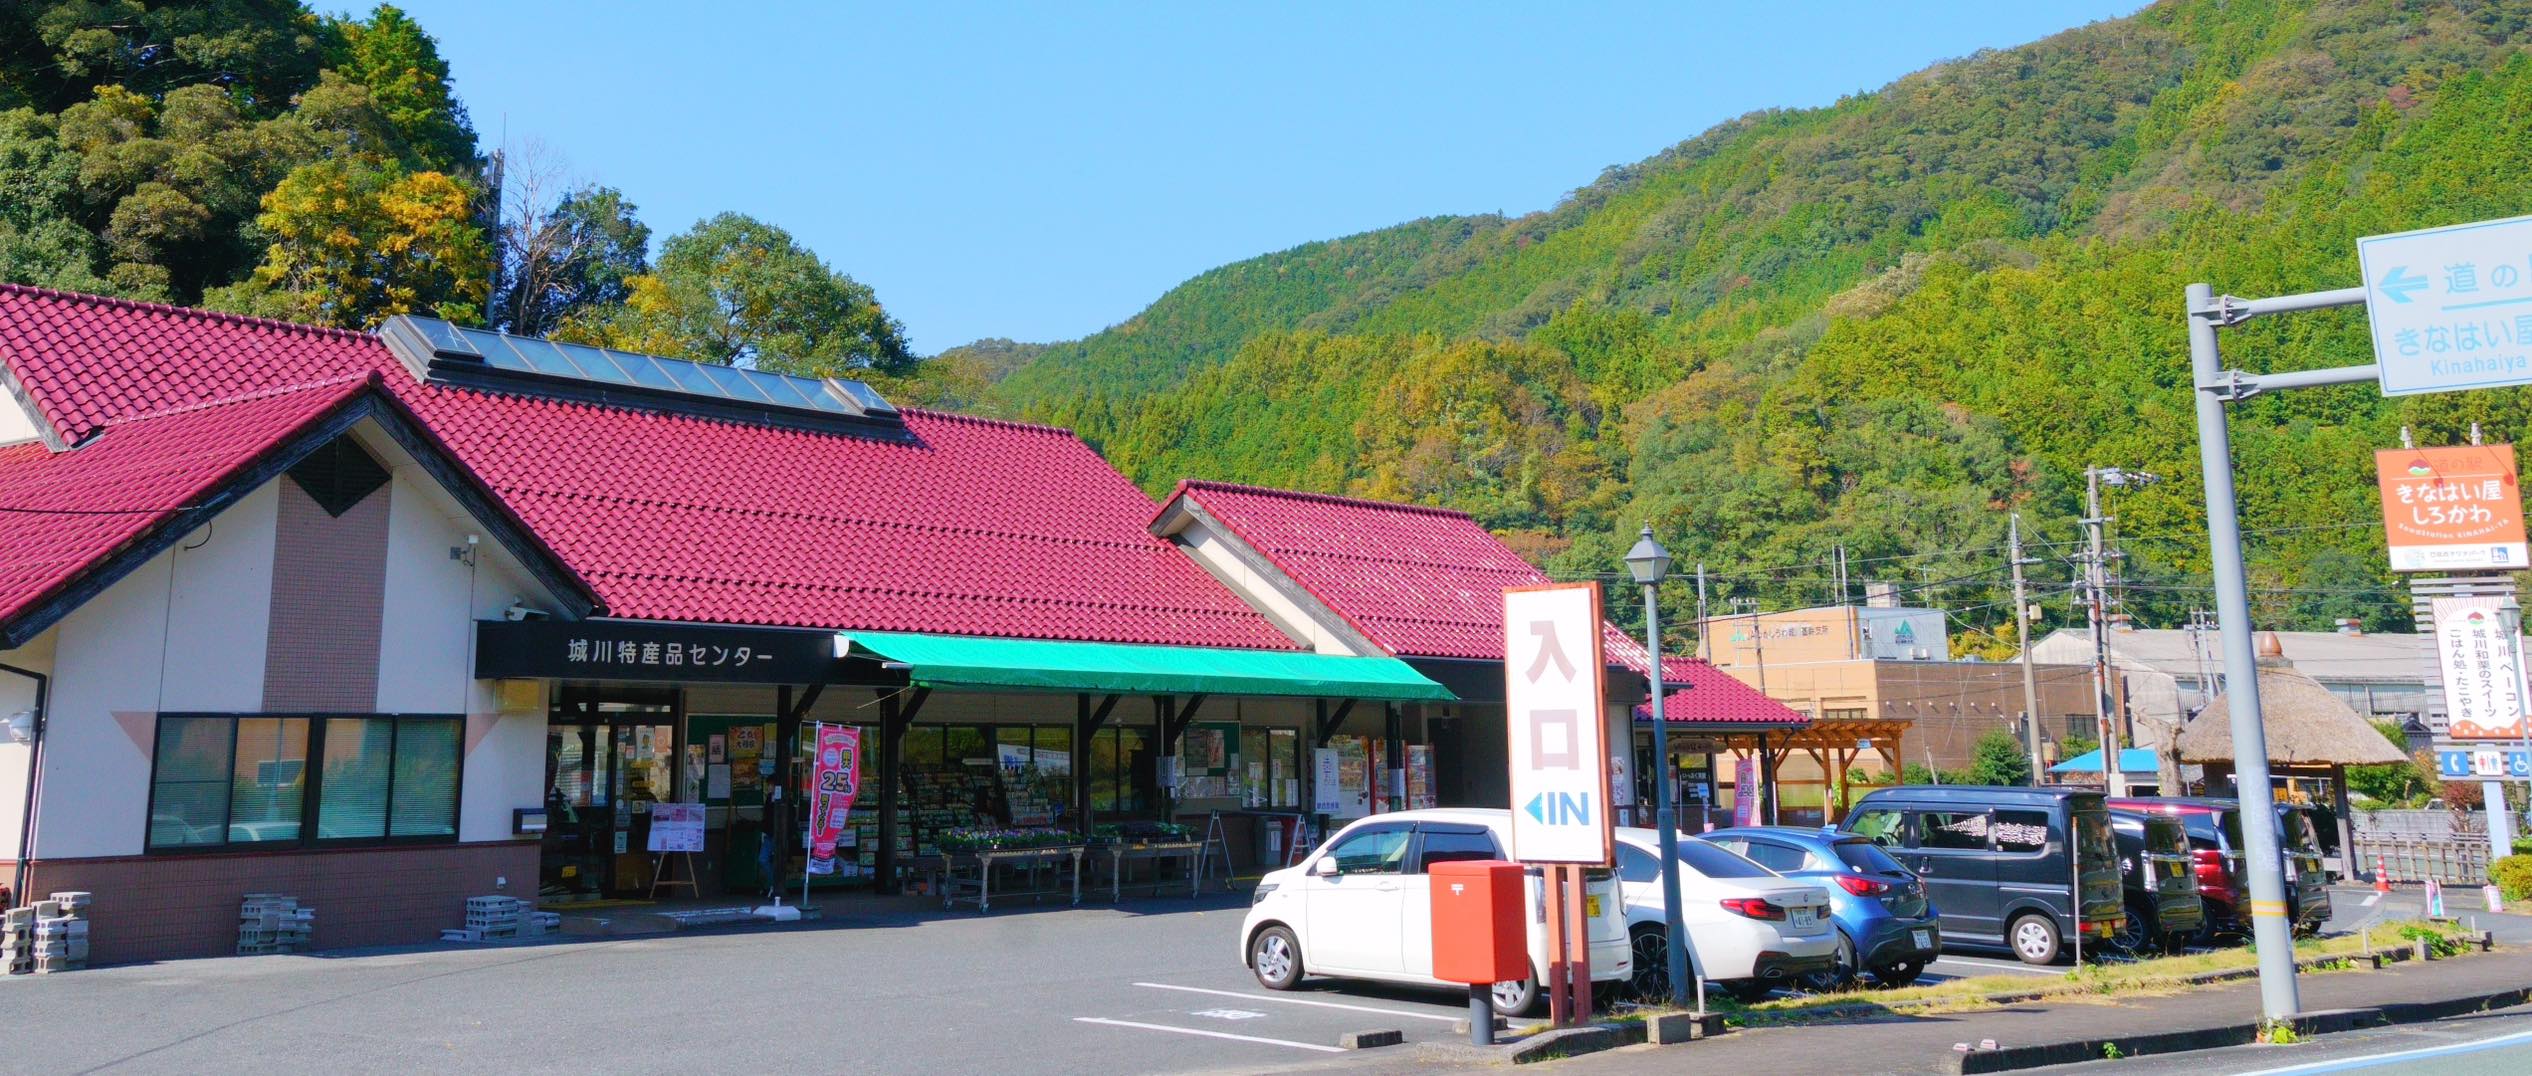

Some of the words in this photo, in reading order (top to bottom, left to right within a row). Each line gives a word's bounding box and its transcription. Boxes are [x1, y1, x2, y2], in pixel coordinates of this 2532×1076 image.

[2443, 254, 2532, 294] 道の
[2431, 354, 2526, 375] Kinahaiya
[2397, 480, 2503, 503] きなはい屋
[2413, 504, 2491, 525] しろかわ
[568, 638, 773, 667] 城川特産品センター
[1525, 620, 1580, 771] 入口
[1548, 791, 1590, 826] IN
